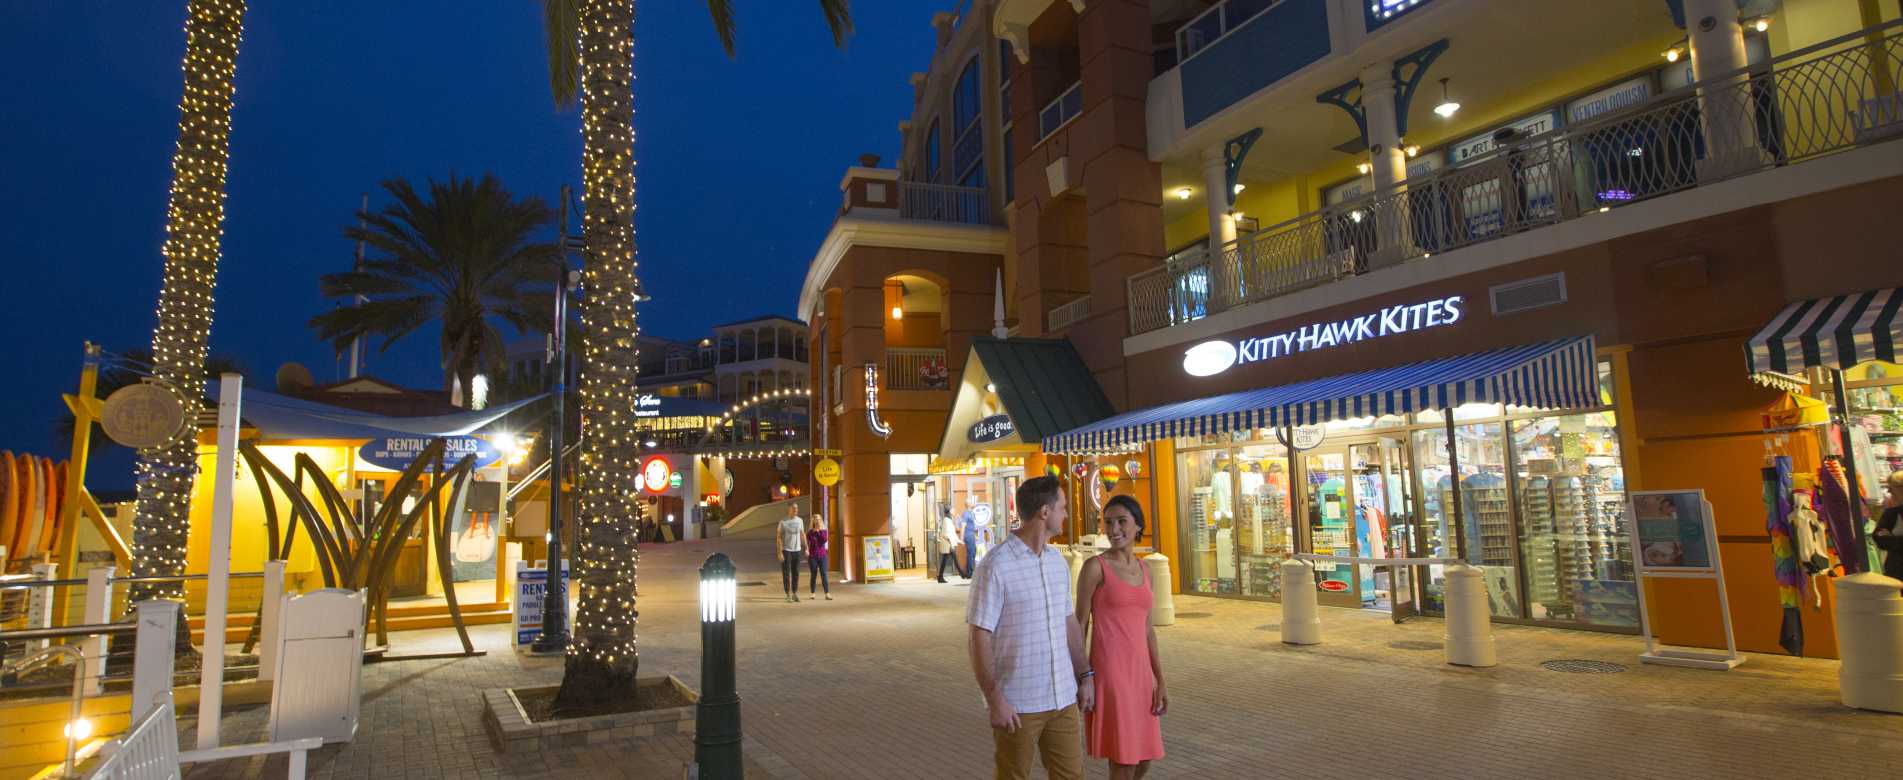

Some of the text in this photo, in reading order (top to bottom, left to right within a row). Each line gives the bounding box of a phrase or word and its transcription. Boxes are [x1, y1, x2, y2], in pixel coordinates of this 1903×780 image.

[1572, 83, 1649, 123] VENTRILOQUISM
[1469, 140, 1489, 157] ART
[1238, 295, 1461, 365] KITTY HAWK KITES
[975, 423, 987, 438] Life
[987, 423, 994, 432] is
[446, 438, 478, 451] SALES
[705, 495, 720, 503] ATM
